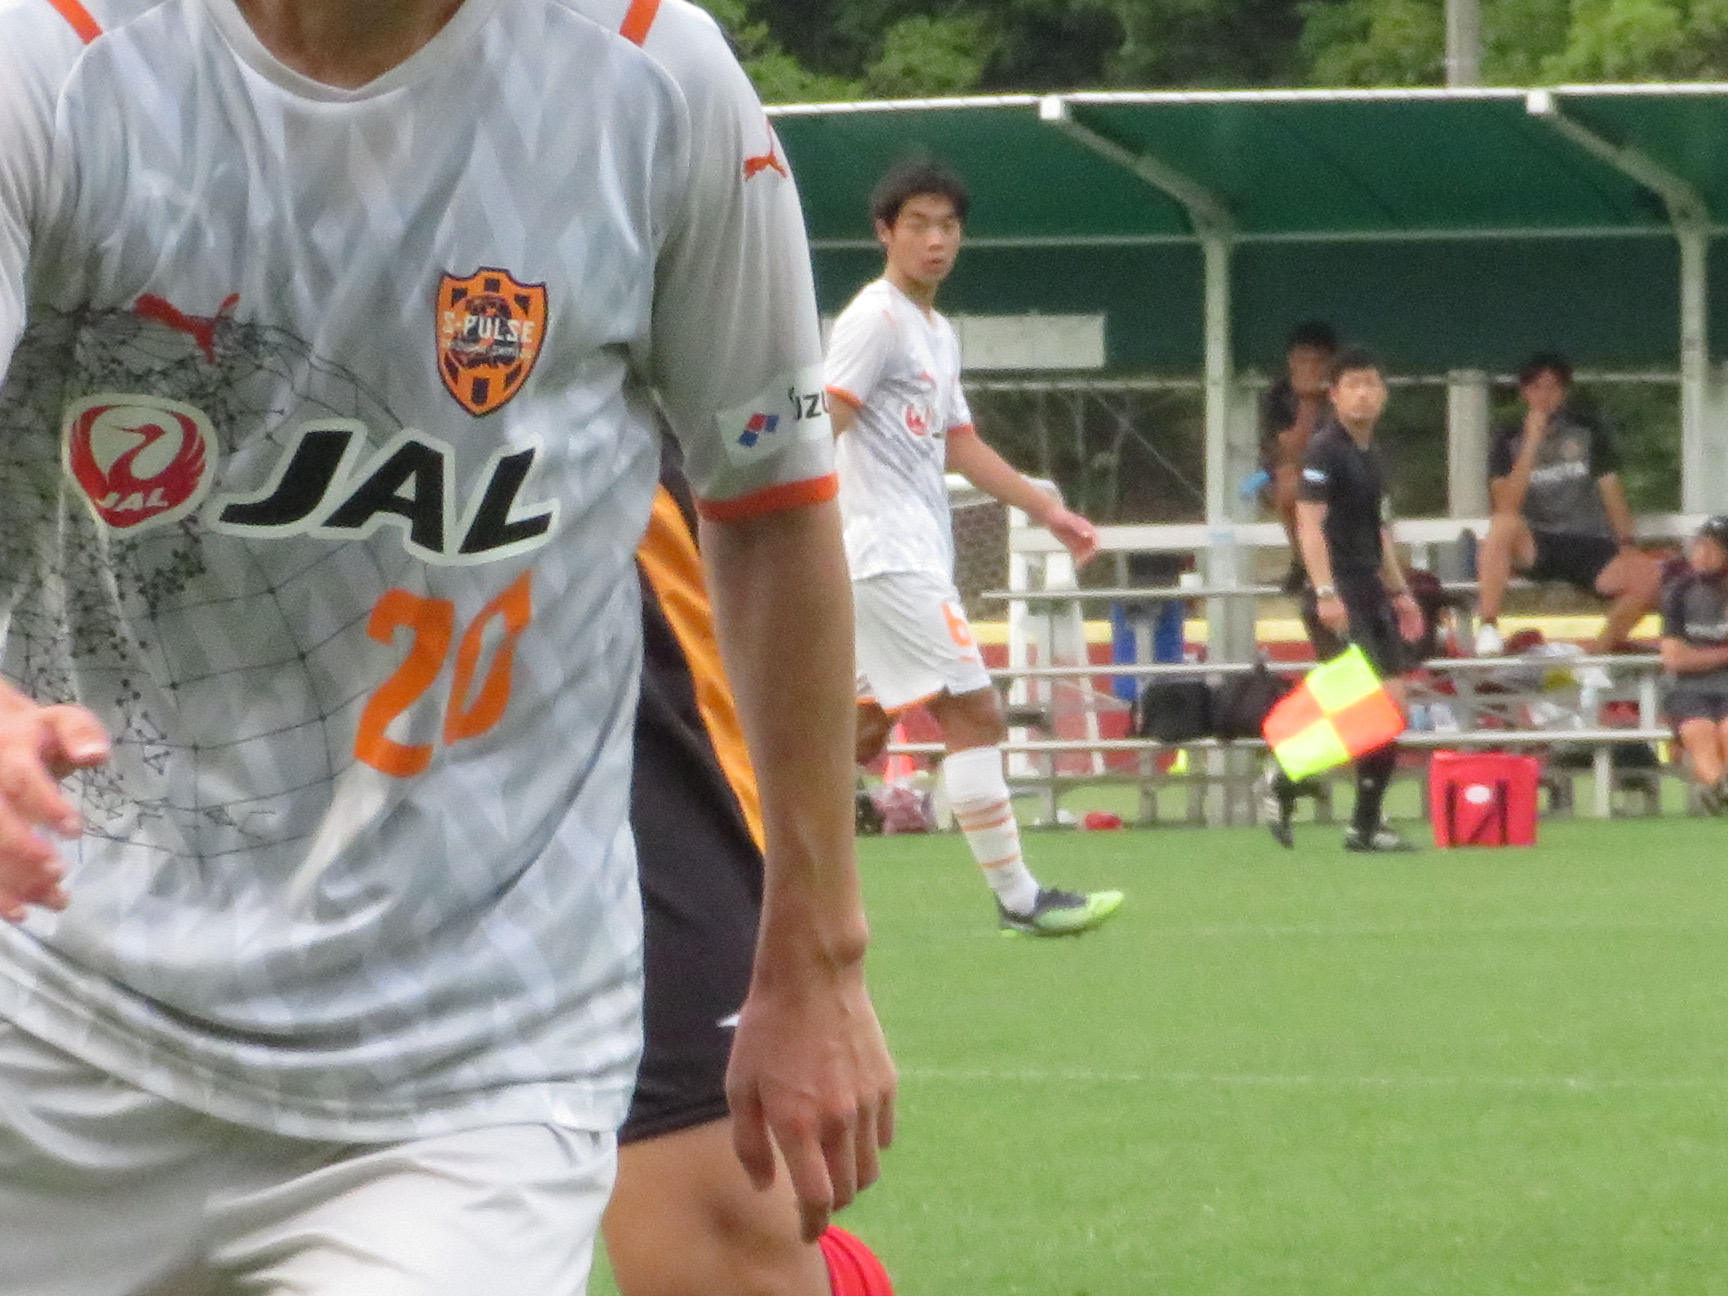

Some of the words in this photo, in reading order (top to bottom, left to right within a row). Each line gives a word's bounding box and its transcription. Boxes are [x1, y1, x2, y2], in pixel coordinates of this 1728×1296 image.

[442, 311, 536, 344] S-PULSE
[94, 487, 169, 512] JAL
[218, 430, 553, 555] JAL
[353, 568, 535, 778] 20
